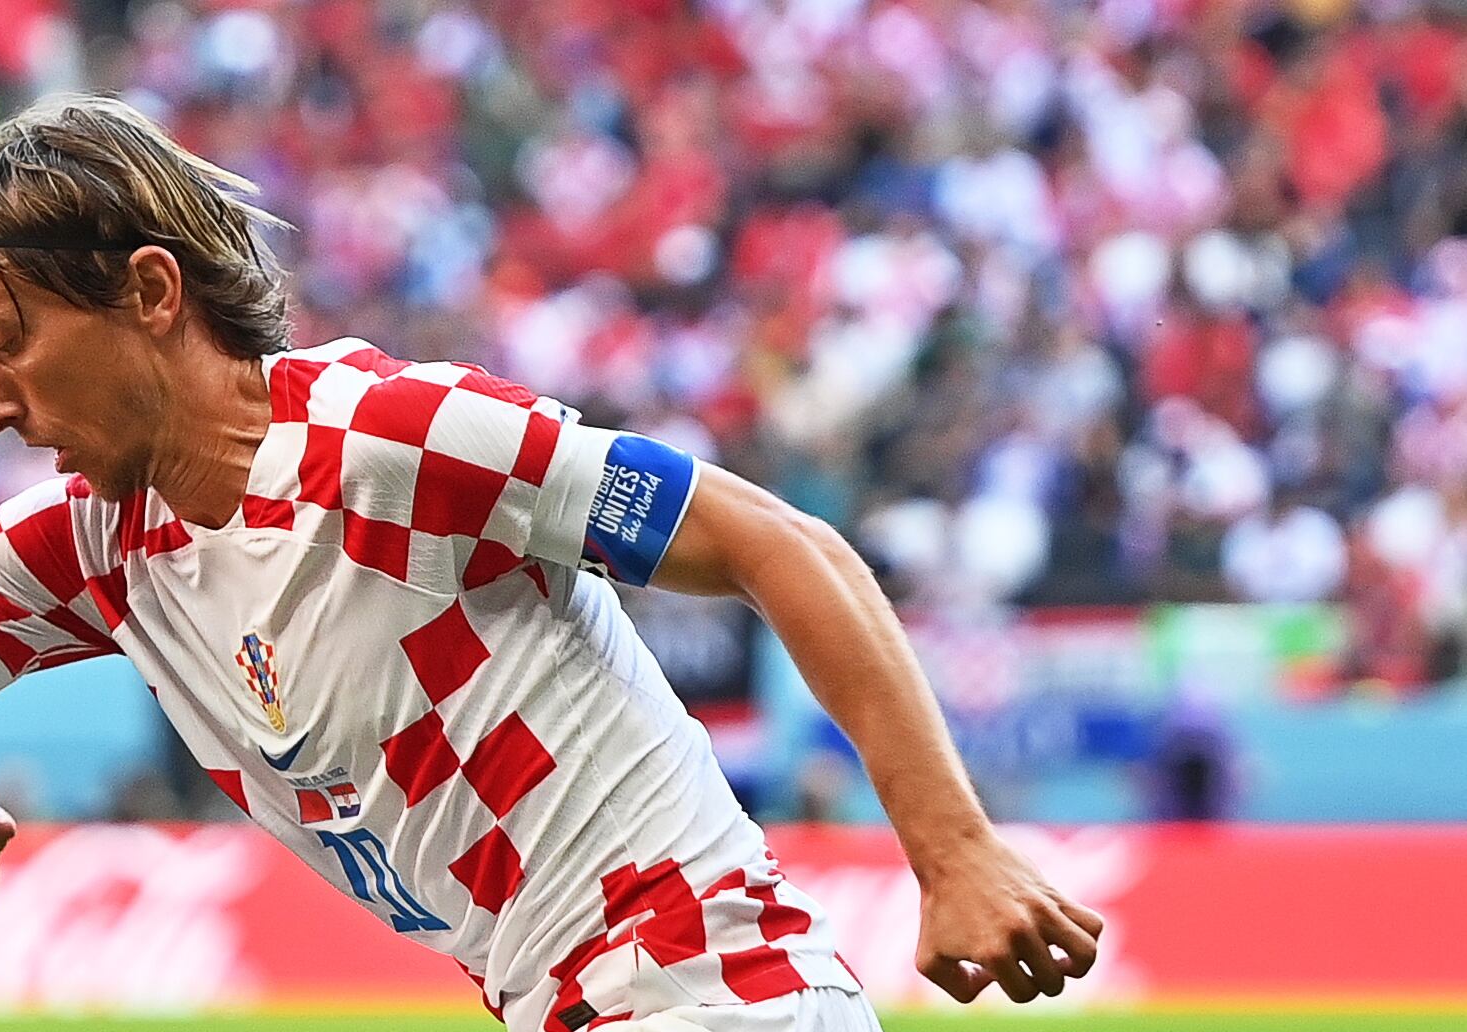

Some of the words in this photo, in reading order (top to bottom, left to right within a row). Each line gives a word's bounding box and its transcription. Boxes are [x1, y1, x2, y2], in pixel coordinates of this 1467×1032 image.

[595, 465, 641, 534] UNITES
[629, 471, 664, 518] World
[621, 517, 642, 543] the
[316, 827, 452, 933] 10
